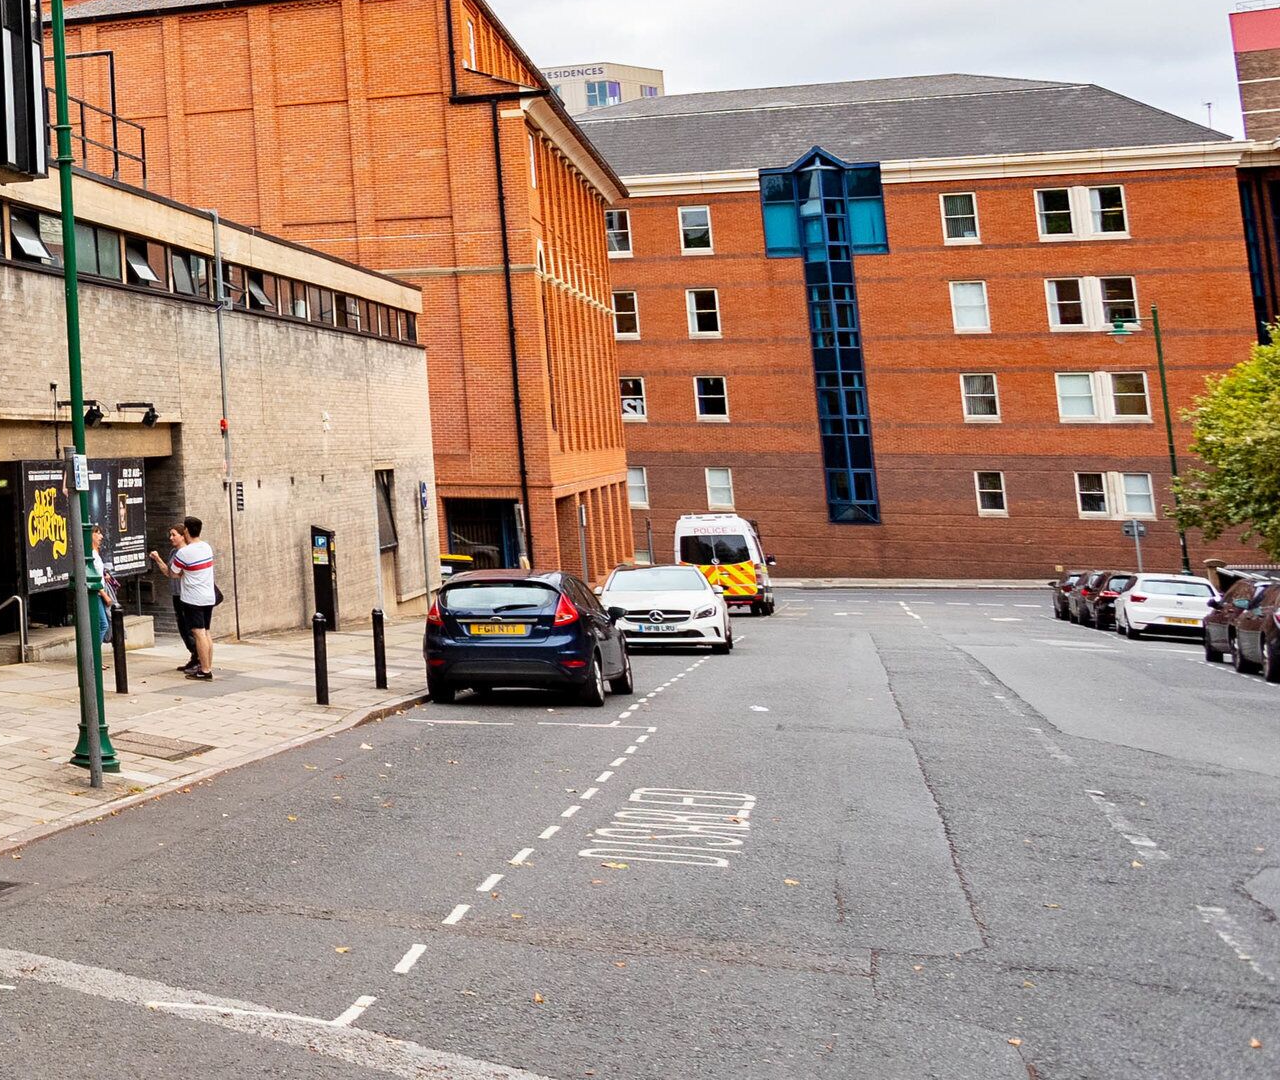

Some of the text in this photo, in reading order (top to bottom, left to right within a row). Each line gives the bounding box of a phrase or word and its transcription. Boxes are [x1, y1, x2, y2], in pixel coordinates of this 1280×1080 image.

[27, 510, 67, 559] CHARITY
[693, 527, 727, 535] POLICE
[578, 787, 757, 868] DISABLED
